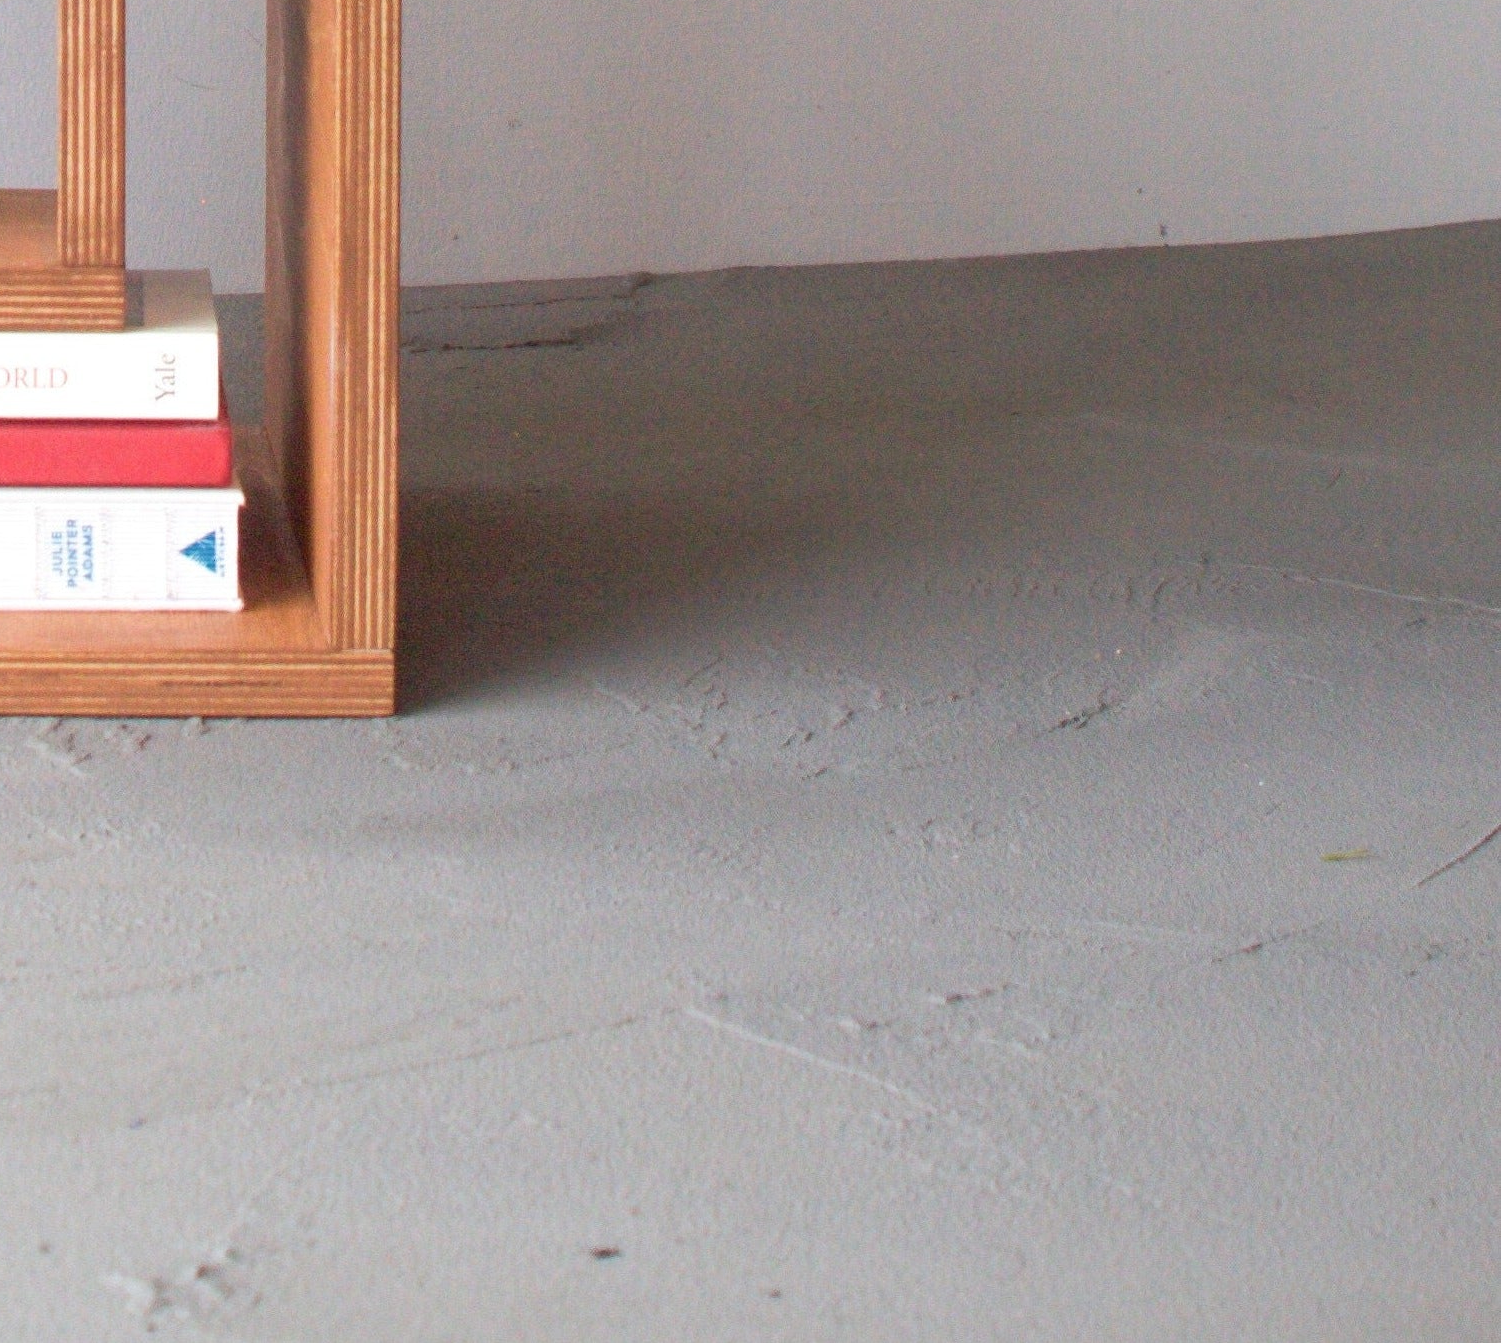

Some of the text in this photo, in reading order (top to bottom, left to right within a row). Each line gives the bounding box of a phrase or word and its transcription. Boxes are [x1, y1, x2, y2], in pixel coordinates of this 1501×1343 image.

[154, 352, 177, 402] Yale
[51, 530, 63, 577] JULIE
[66, 518, 78, 589] POINTER
[81, 524, 93, 582] ADAMS
